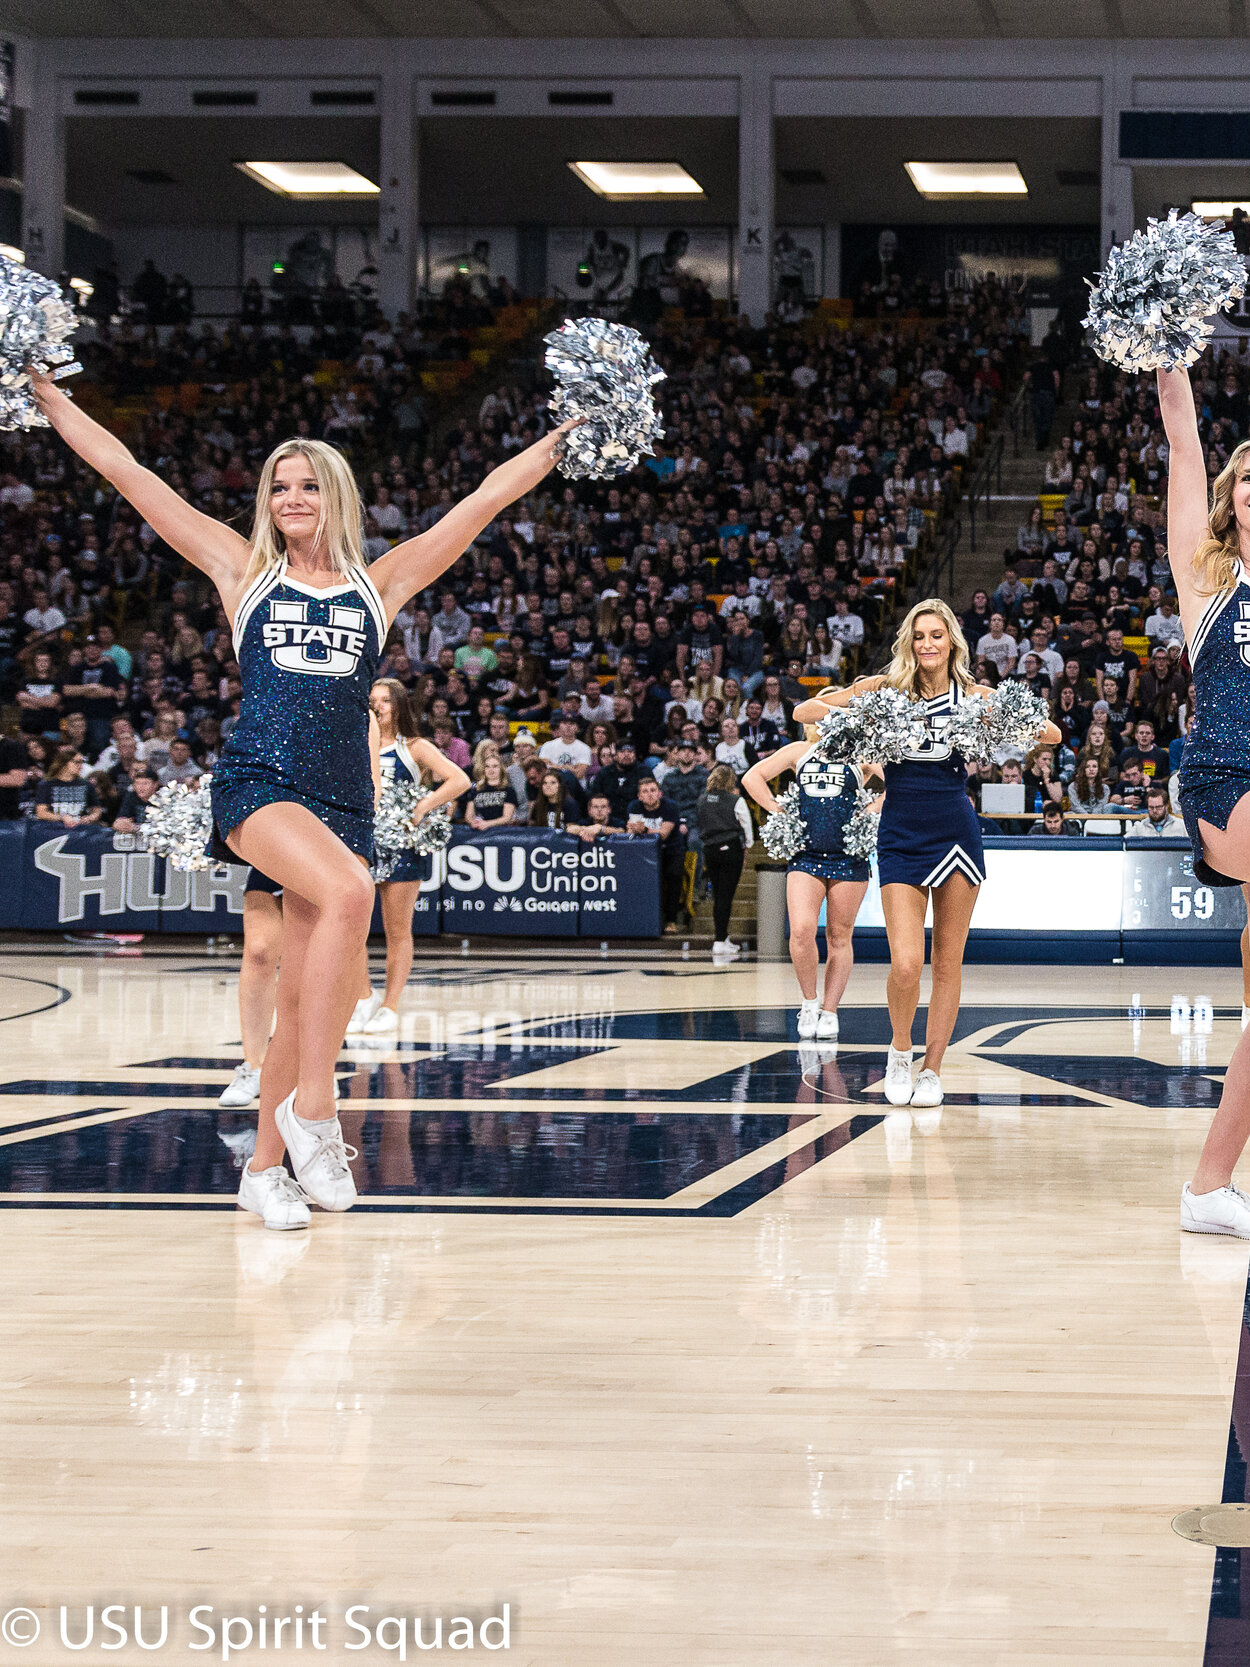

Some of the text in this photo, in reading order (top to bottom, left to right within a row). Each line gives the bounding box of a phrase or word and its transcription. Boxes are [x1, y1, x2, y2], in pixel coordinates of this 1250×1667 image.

[387, 229, 399, 243] J
[747, 228, 761, 244] K
[262, 623, 367, 657] STATE
[800, 772, 846, 787] STATE
[530, 846, 617, 869] Credit
[34, 834, 253, 923] HUR
[531, 871, 618, 893] Union
[1170, 886, 1215, 920] 59
